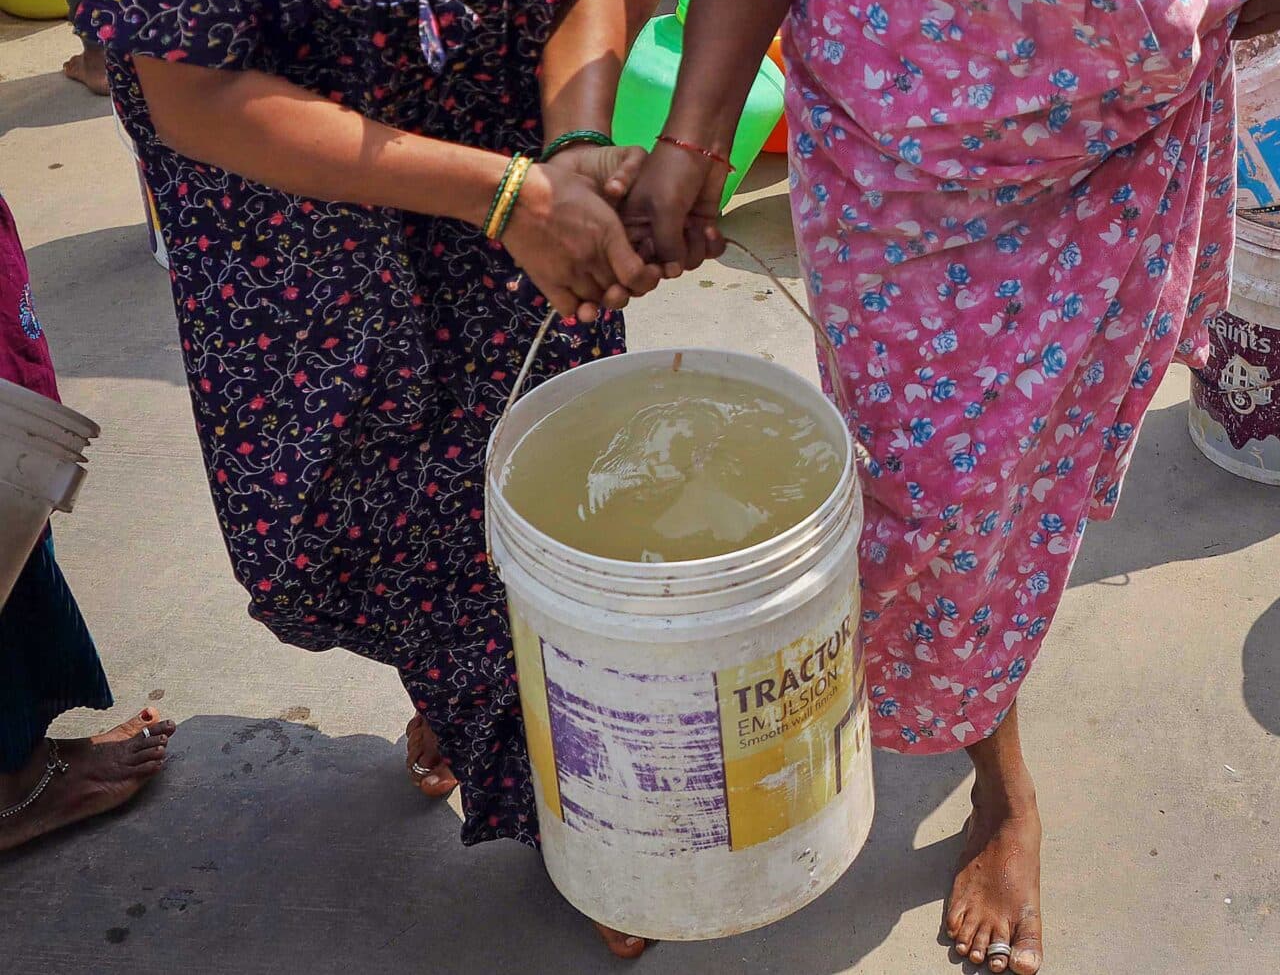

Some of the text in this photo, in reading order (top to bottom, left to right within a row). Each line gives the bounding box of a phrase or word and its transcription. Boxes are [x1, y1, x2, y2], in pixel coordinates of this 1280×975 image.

[1209, 315, 1271, 354] aints
[733, 614, 851, 714] TRACTOR
[739, 723, 790, 750] Smooth
[815, 685, 838, 712] finish
